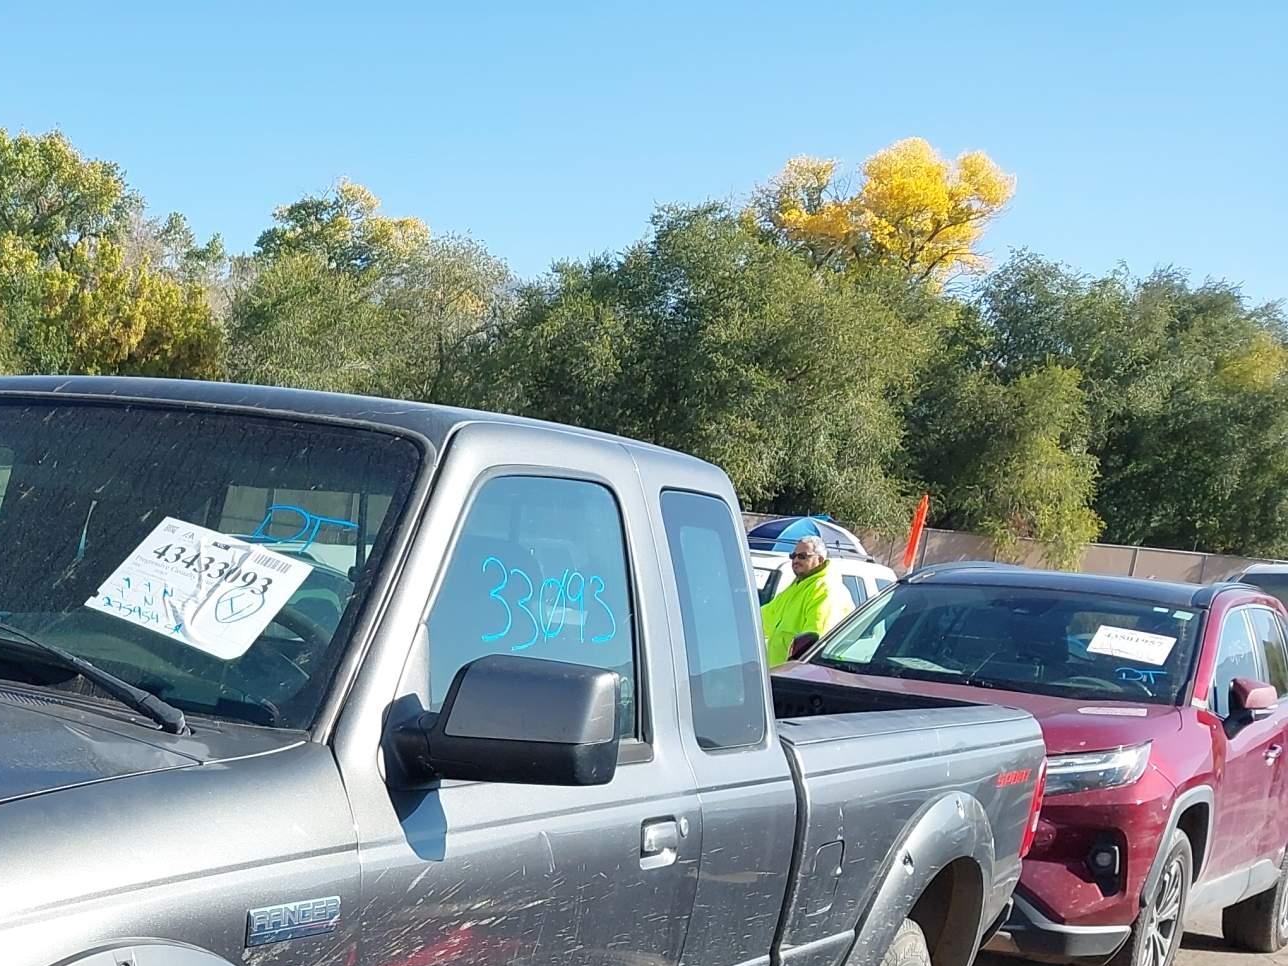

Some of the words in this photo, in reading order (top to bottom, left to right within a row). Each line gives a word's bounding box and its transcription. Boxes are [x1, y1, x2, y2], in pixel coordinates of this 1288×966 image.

[152, 543, 273, 596] 43433093
[481, 556, 616, 651] 33093
[251, 898, 340, 932] RANGER
